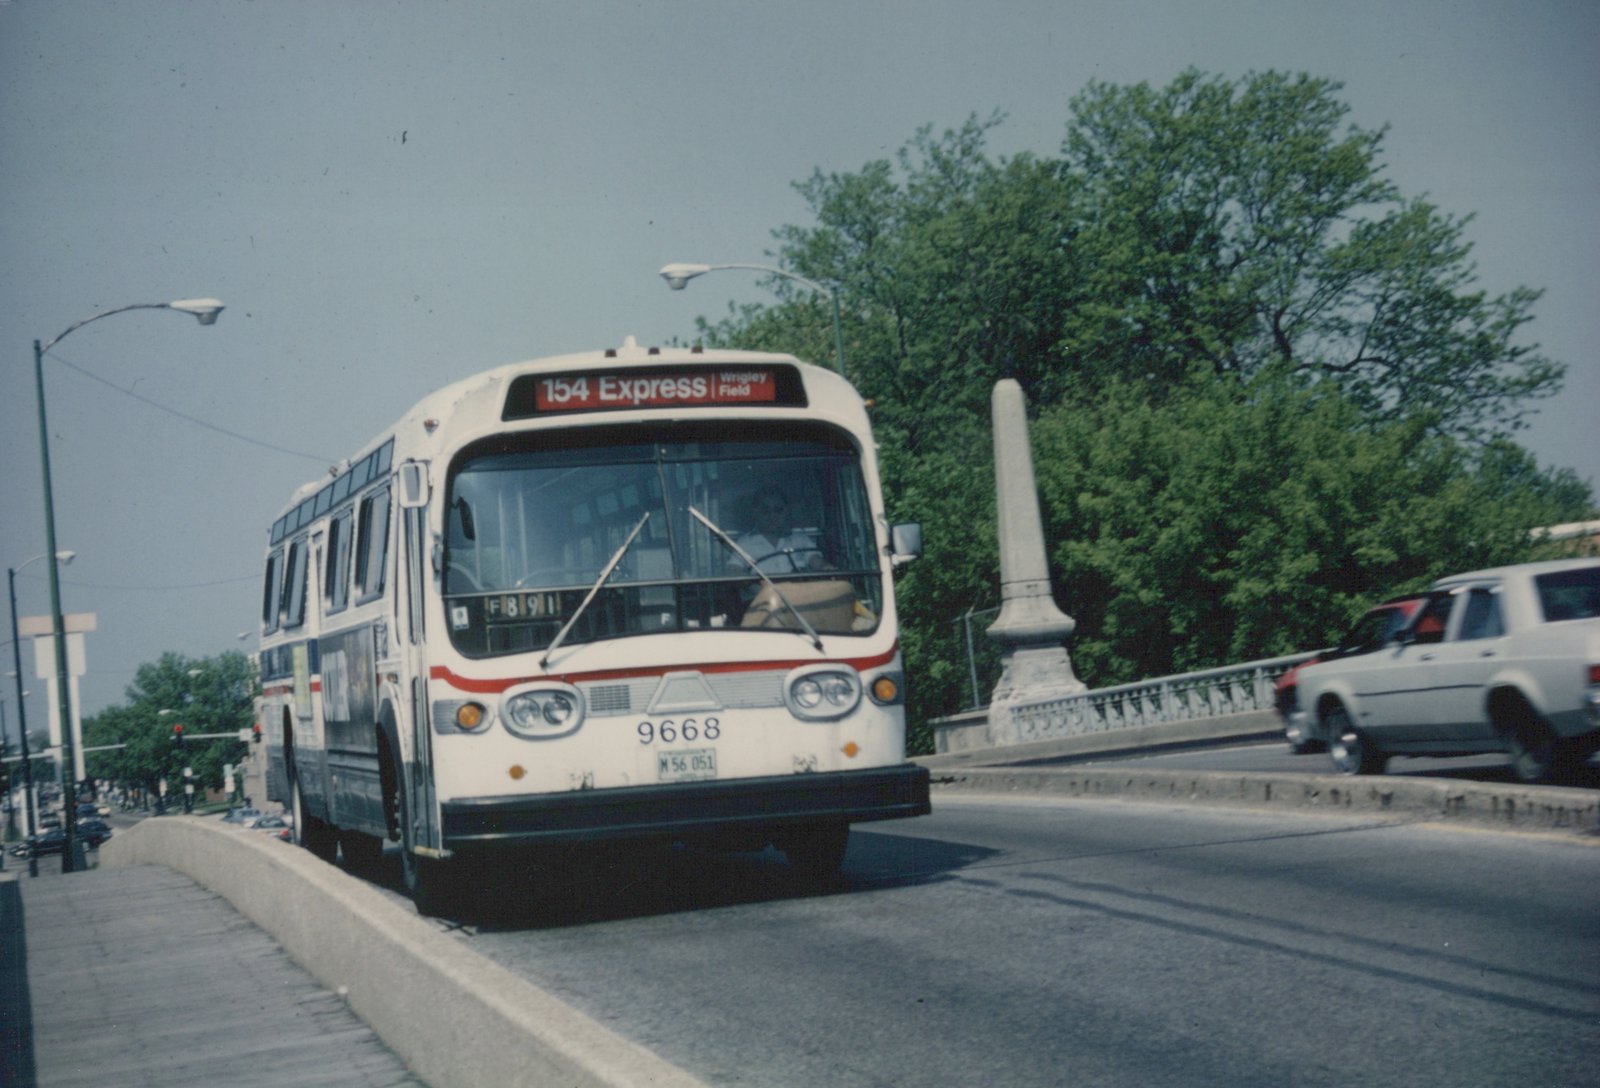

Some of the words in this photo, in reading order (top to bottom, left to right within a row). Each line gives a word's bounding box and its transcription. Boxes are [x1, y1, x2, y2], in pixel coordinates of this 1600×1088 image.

[720, 372, 767, 384] Wrigley
[542, 377, 590, 402] 154
[599, 376, 707, 404] Express
[719, 384, 750, 396] Field
[637, 717, 721, 744] 9668
